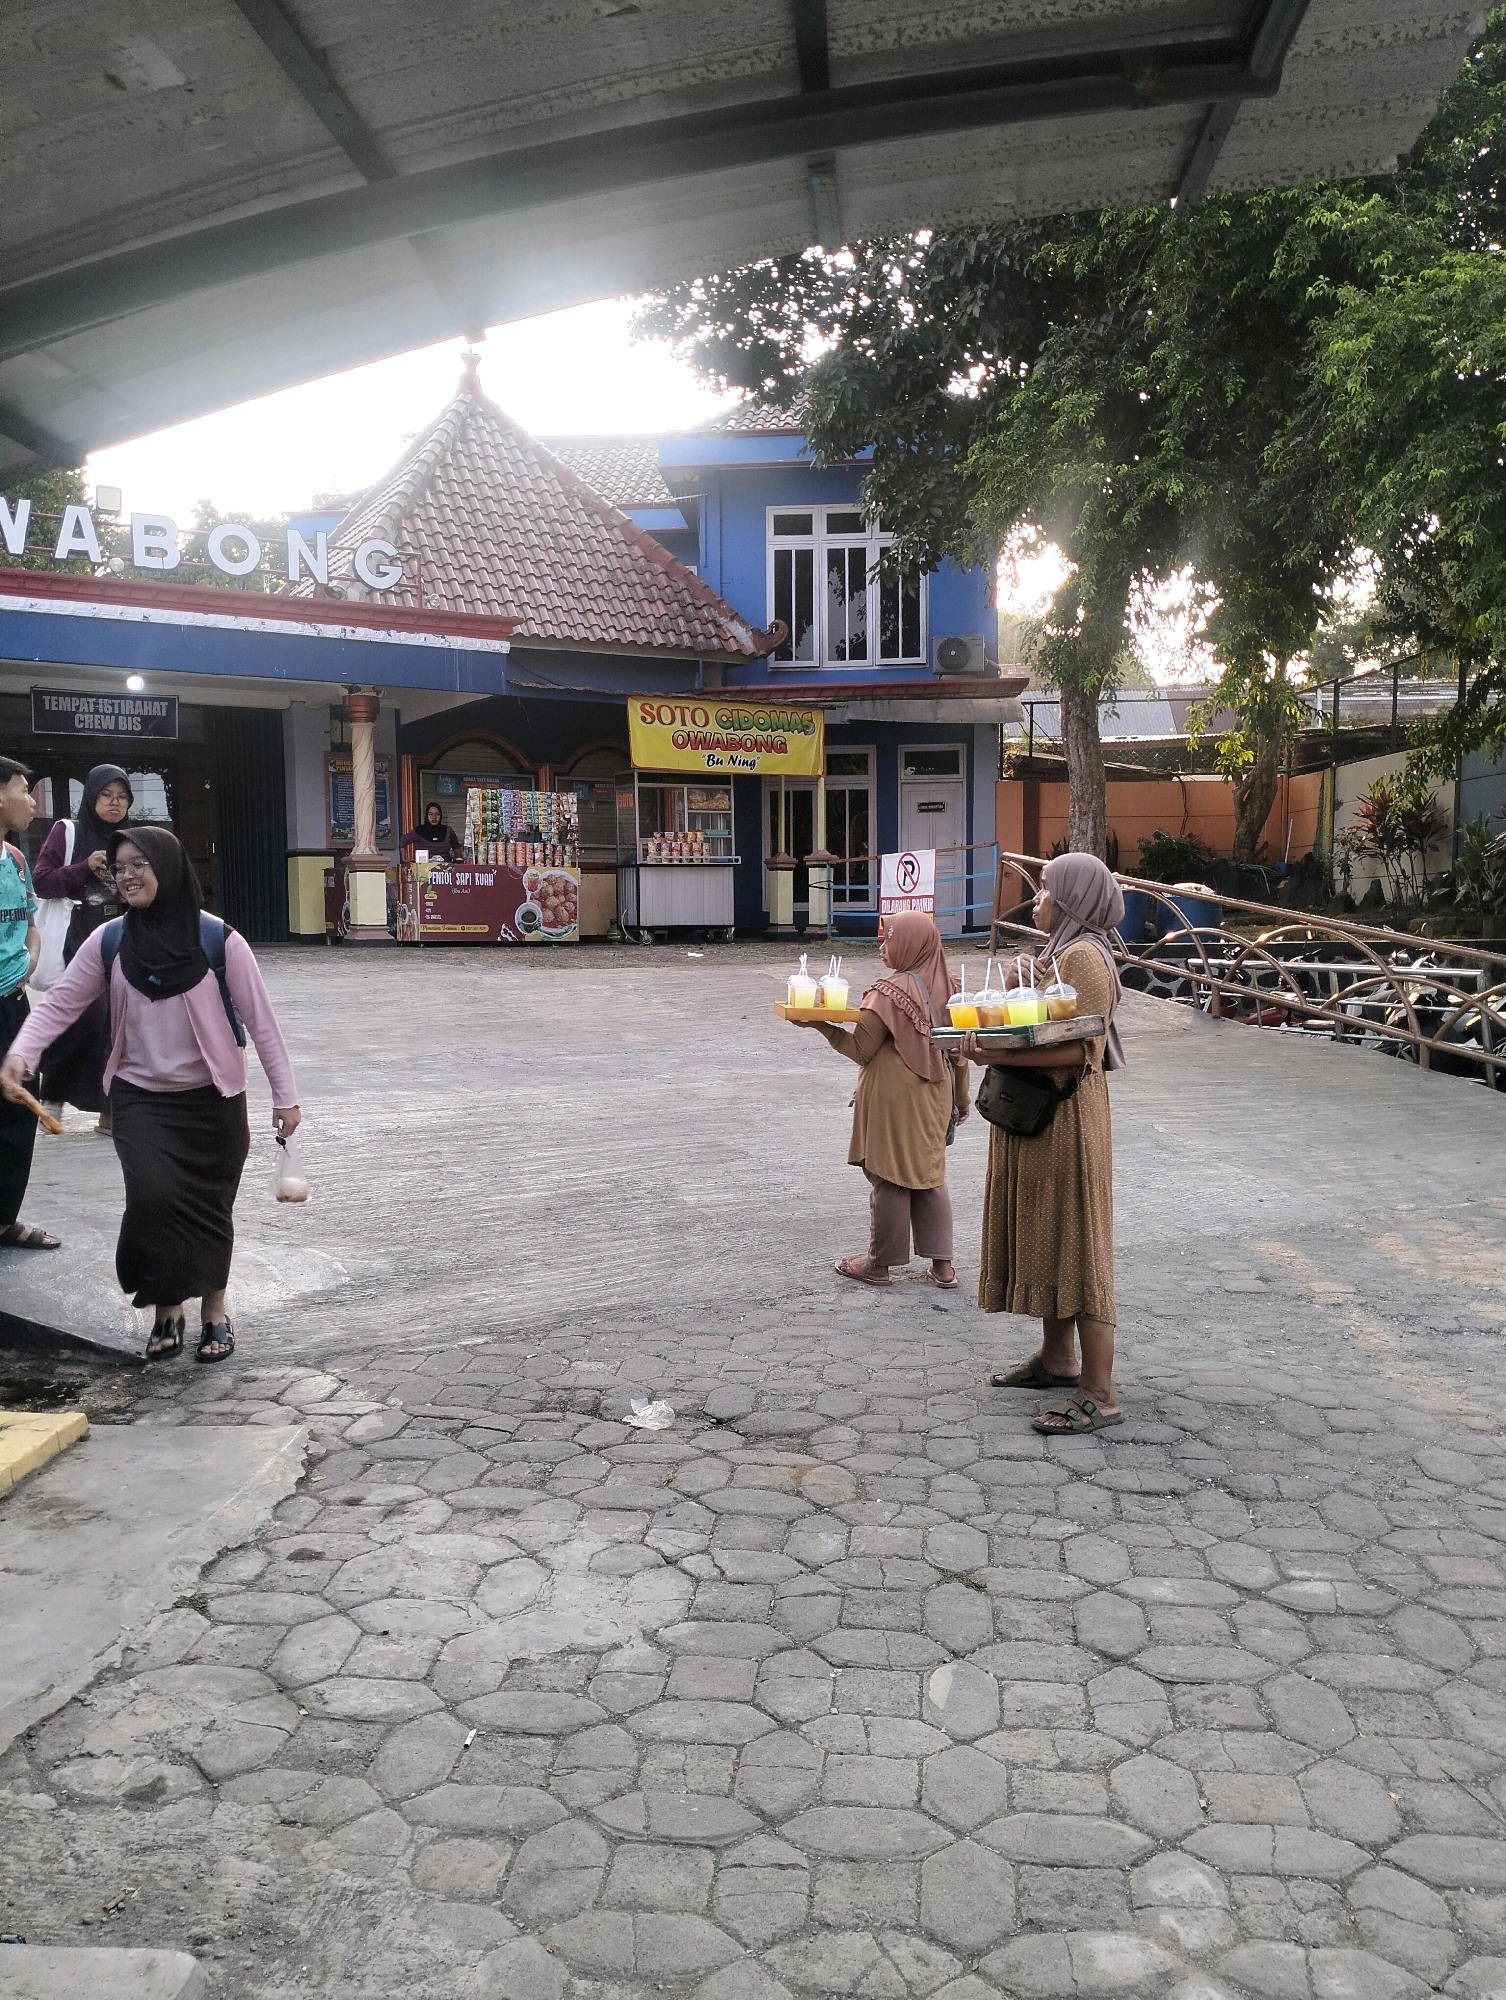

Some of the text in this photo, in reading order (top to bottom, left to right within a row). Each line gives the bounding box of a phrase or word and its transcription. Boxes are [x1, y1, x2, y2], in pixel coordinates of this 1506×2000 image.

[43, 695, 168, 717] TEMPAT ISTIRAHAT
[74, 713, 142, 731] CREW BIS
[639, 702, 815, 735] SOTO CIDOMAS
[672, 730, 788, 754] OWABONG
[443, 783, 453, 794] 3
[428, 871, 494, 886] PENTOL SAPI KUAH
[881, 897, 934, 914] DILARANG PARKIR
